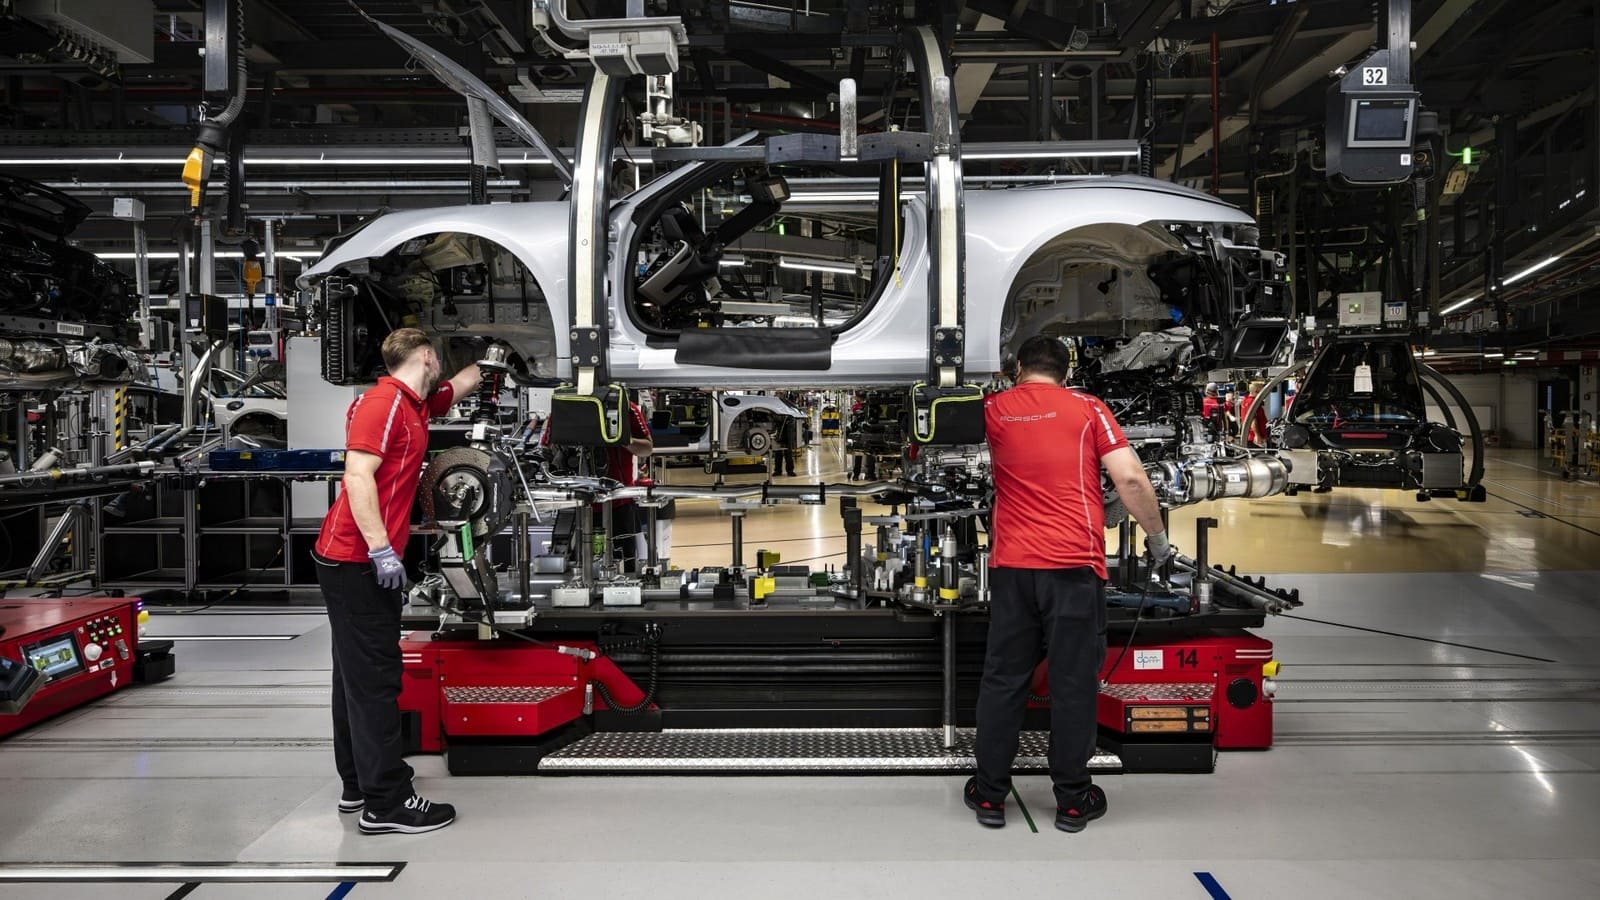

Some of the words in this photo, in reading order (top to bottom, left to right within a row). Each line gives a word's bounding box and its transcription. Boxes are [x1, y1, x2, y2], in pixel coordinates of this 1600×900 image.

[1366, 68, 1384, 84] 32
[1390, 307, 1401, 316] 10
[1175, 648, 1199, 669] 14
